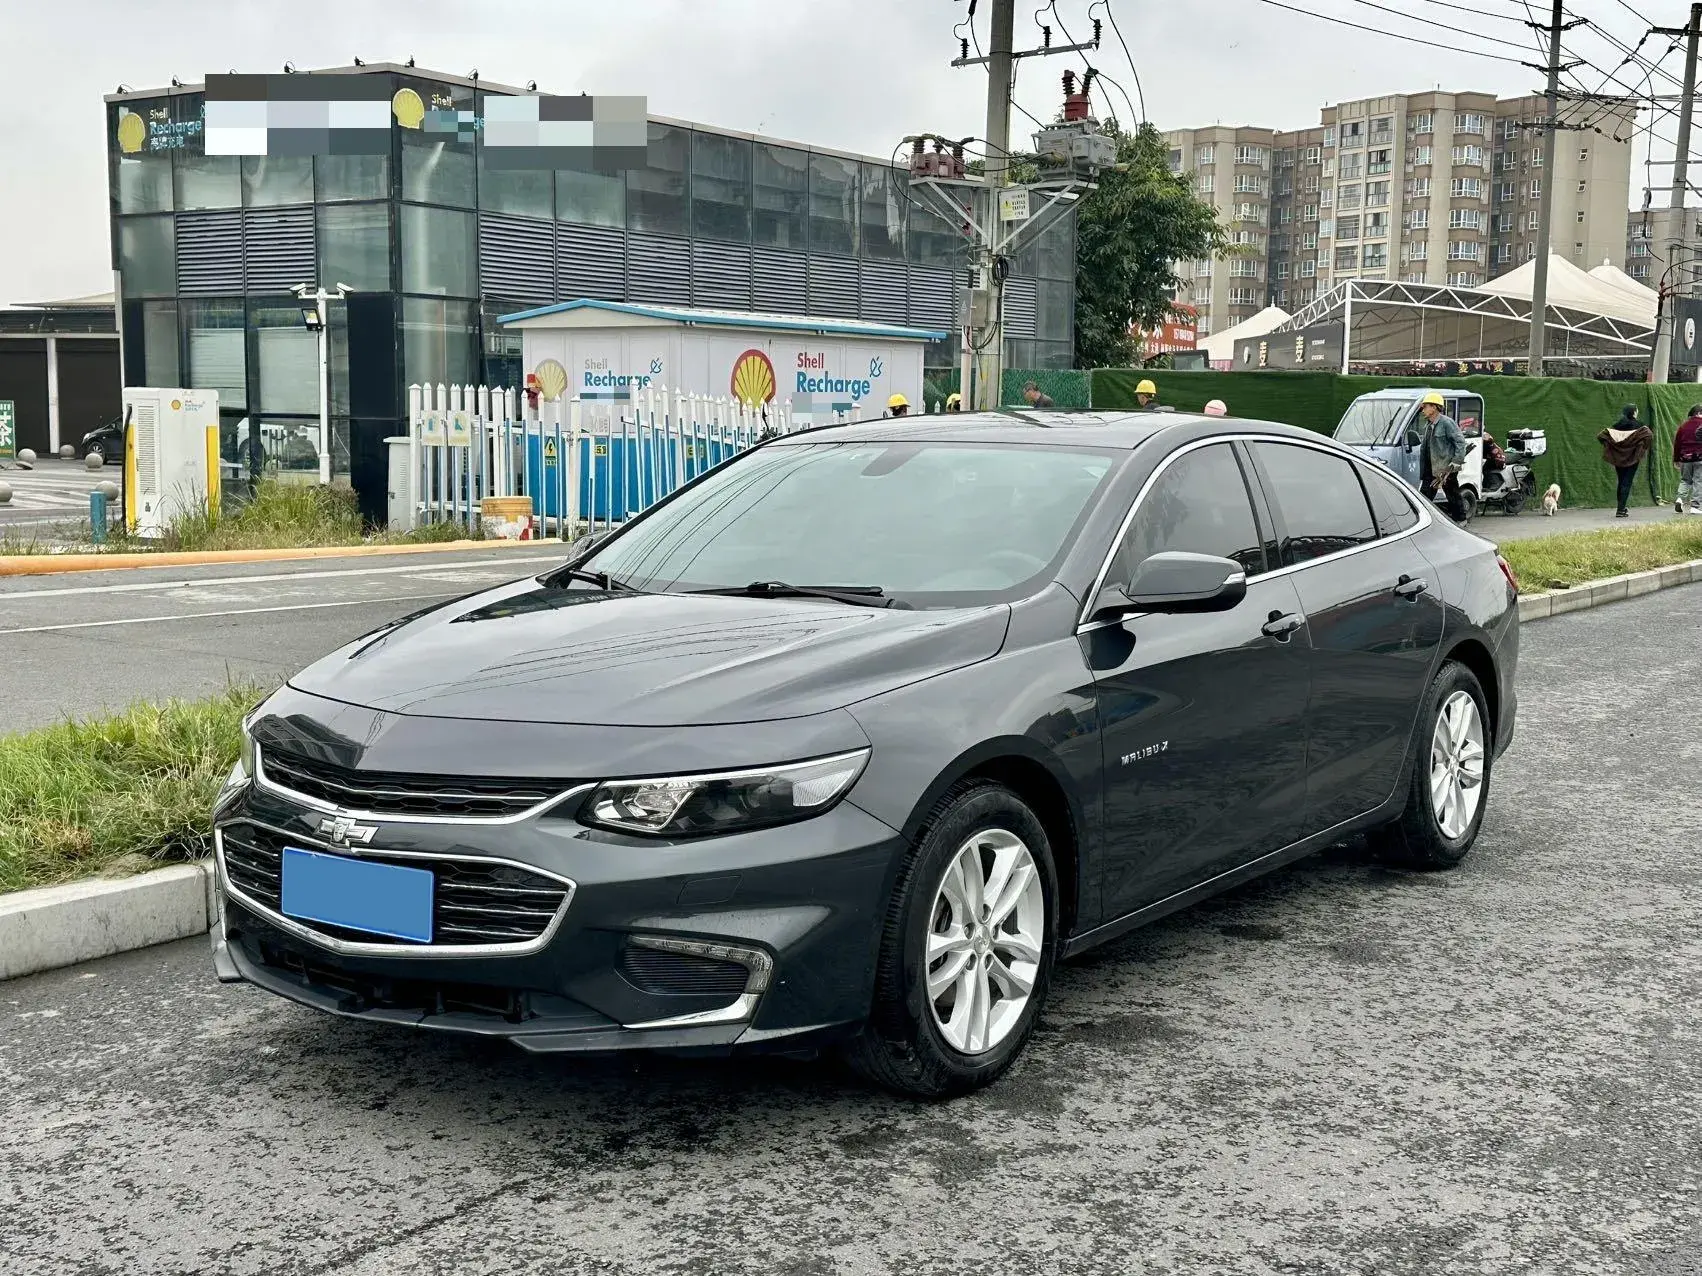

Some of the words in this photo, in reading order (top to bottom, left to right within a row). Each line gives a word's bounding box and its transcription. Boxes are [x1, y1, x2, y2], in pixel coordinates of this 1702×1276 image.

[432, 93, 452, 107] Shell
[149, 107, 168, 119] Shell
[149, 118, 202, 135] Recharge
[584, 358, 608, 370] Shell
[797, 352, 824, 369] Shell
[796, 370, 871, 401] Recharge
[1121, 744, 1159, 766] MALIBU
